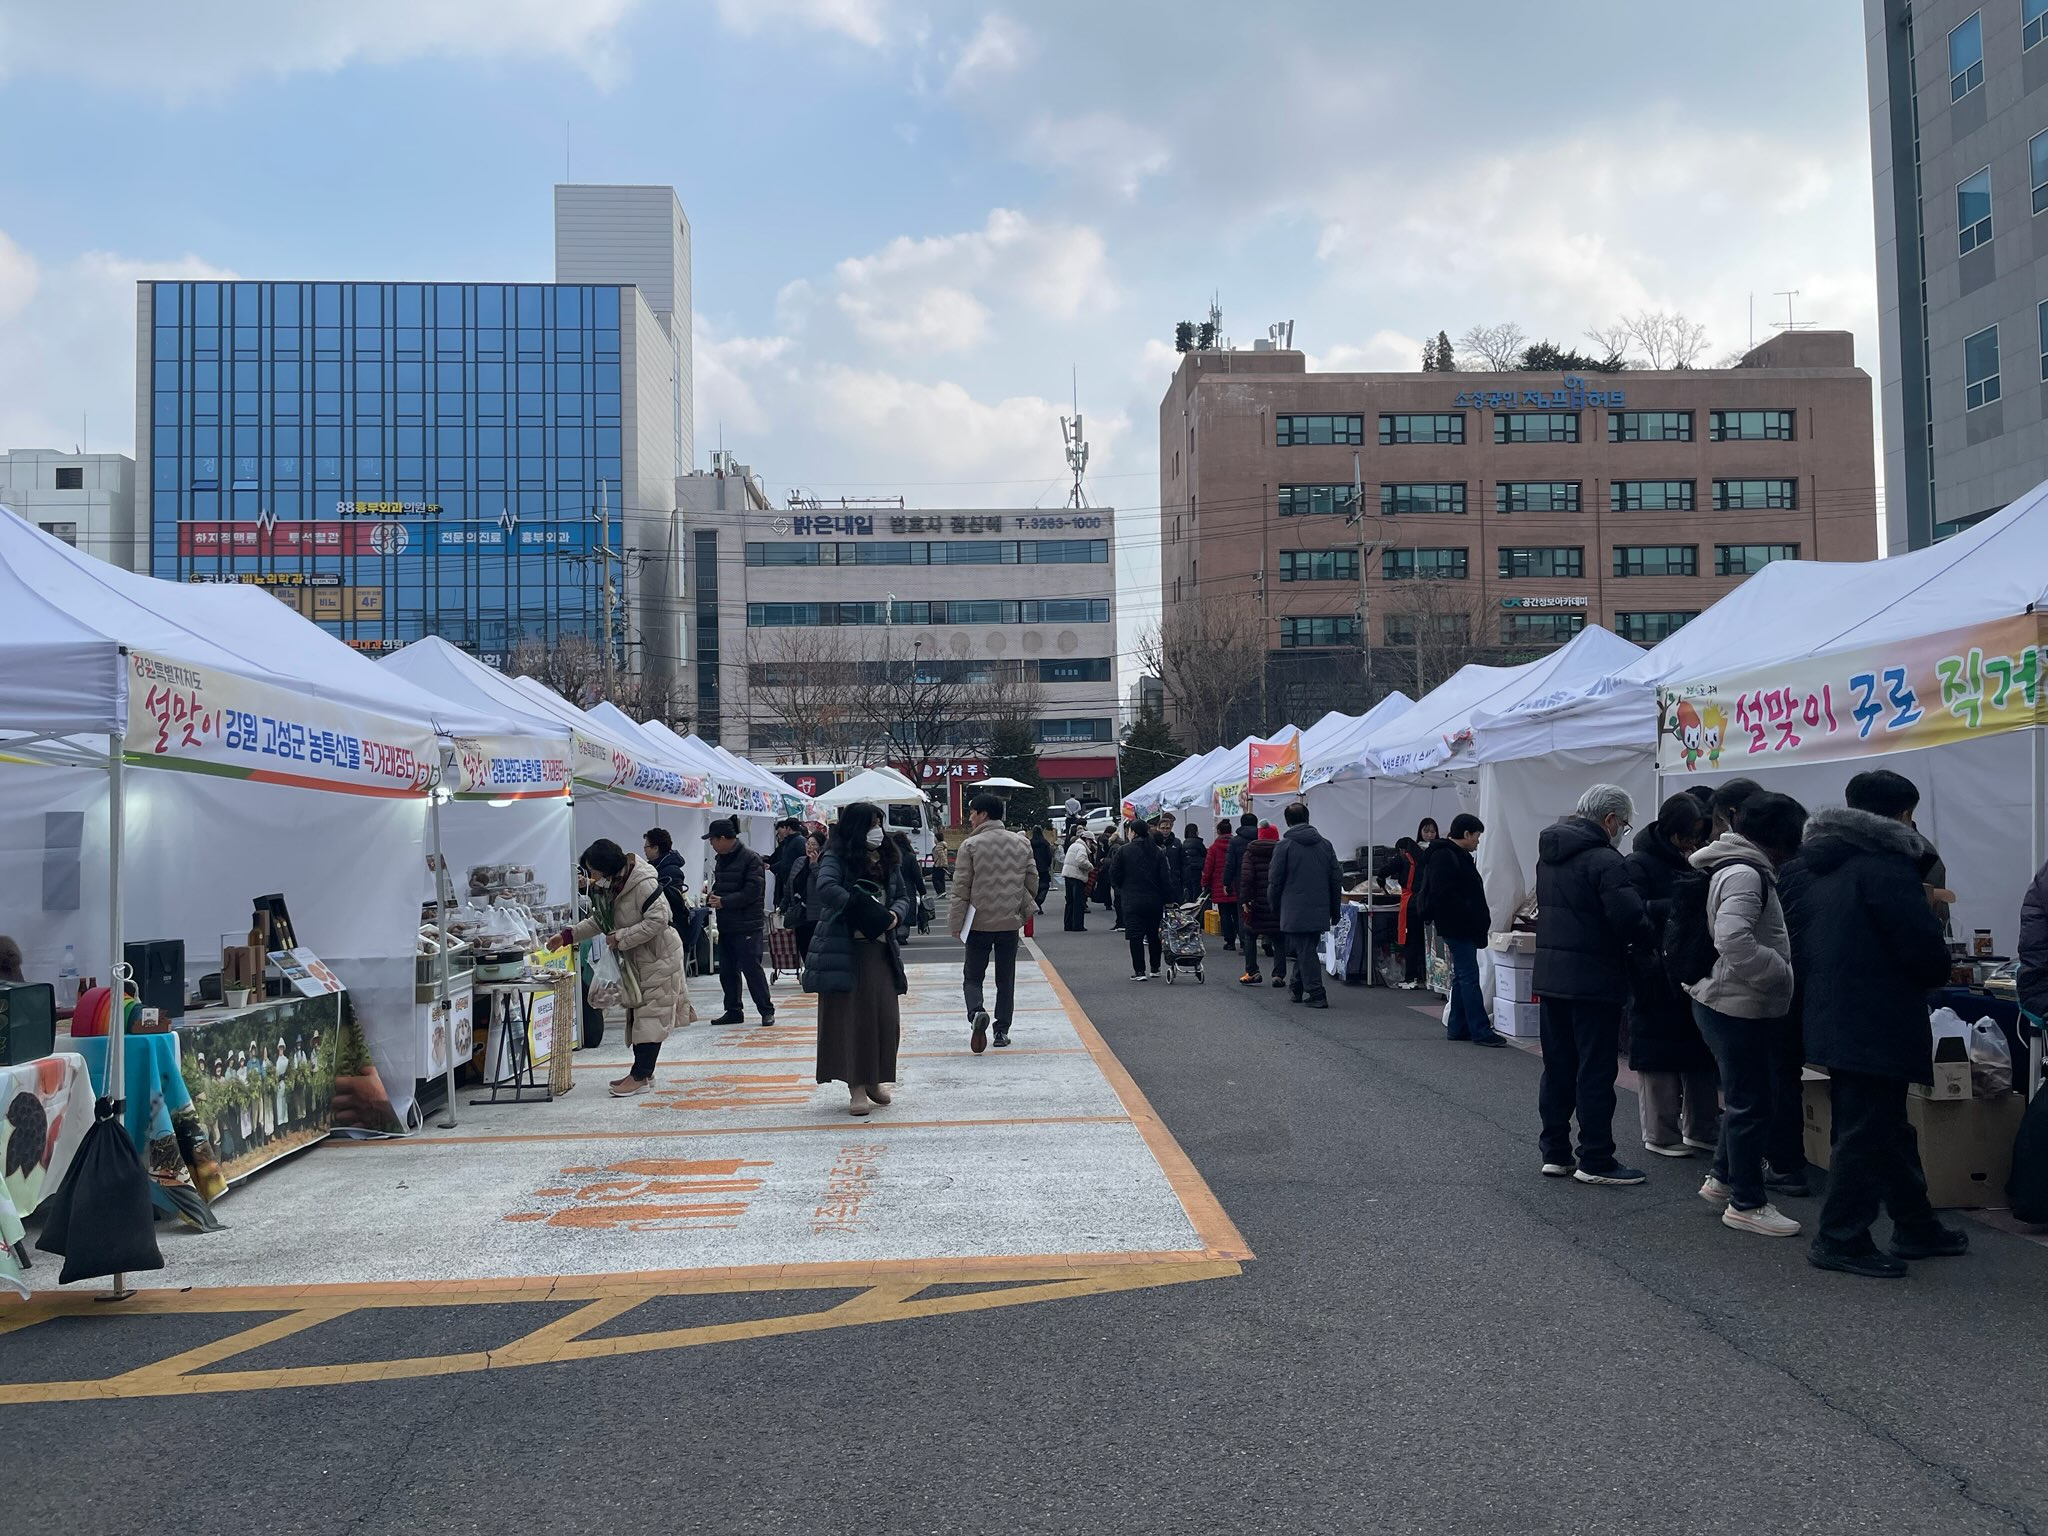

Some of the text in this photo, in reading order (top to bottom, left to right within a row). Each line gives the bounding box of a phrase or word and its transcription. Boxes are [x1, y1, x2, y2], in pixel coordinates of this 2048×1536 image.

[1454, 391, 1518, 408] 소상공인
[793, 515, 874, 535] 밝은내일
[195, 532, 257, 544] 하지정맥류
[521, 532, 570, 543] 흉부외과
[1521, 596, 1588, 607] 공간정보아카데미
[133, 655, 203, 690] 강원특별자치도
[1736, 650, 2048, 754] 설맞이 구로 직거
[145, 684, 415, 780] 설맞이 강원 고성군 농특산물 직거래장터
